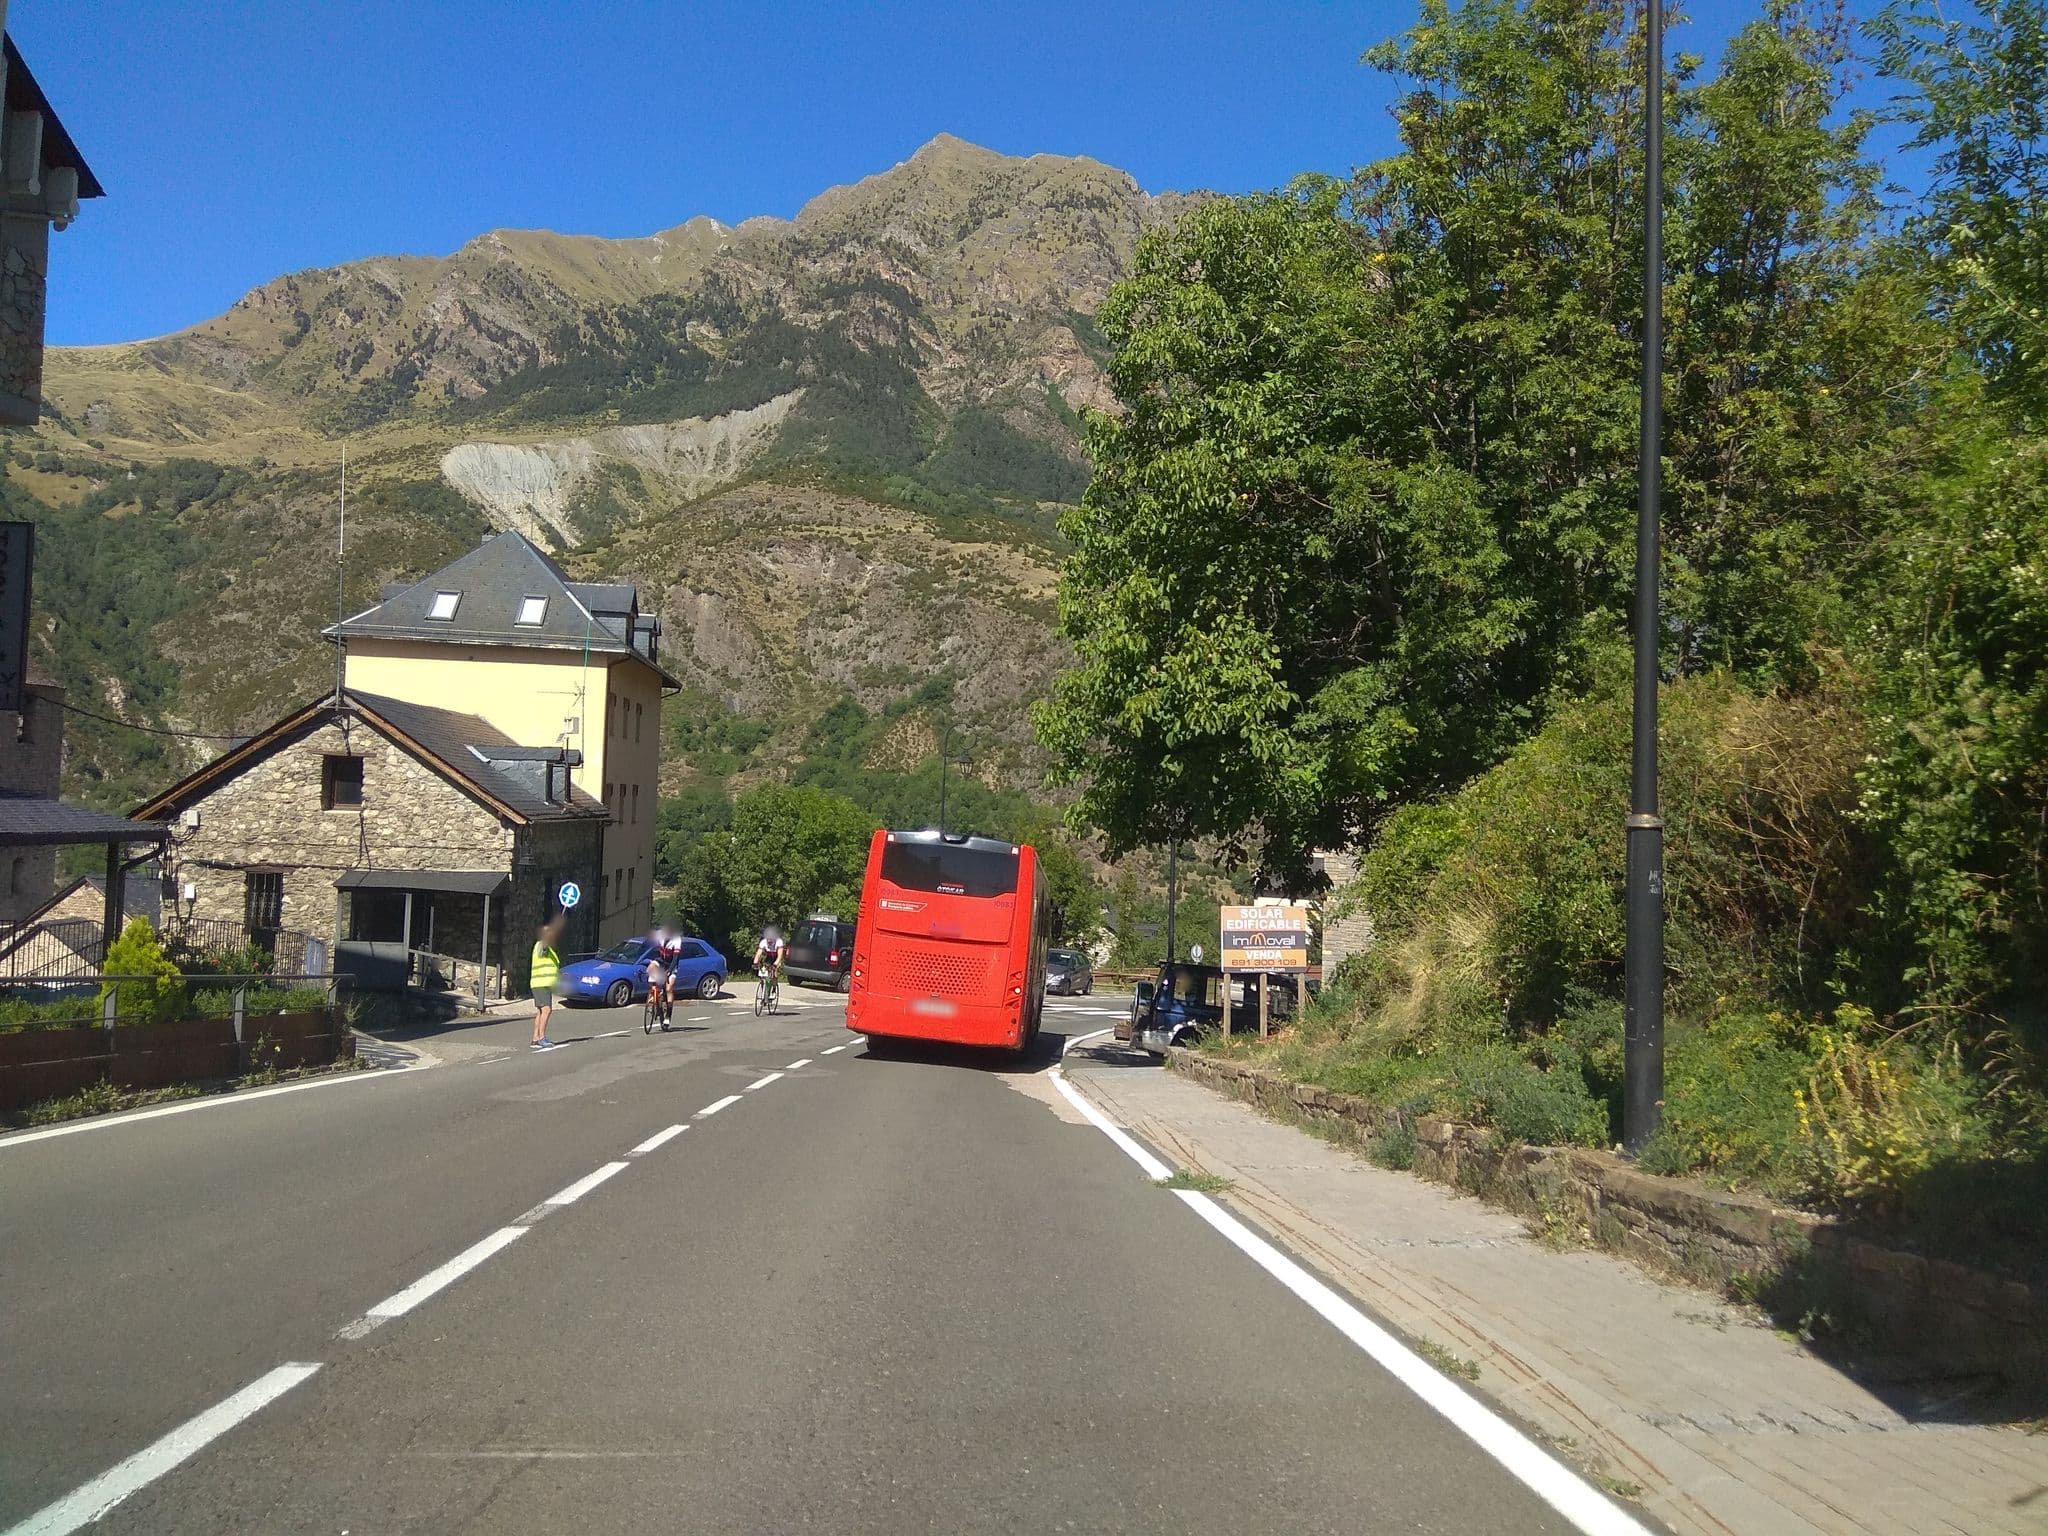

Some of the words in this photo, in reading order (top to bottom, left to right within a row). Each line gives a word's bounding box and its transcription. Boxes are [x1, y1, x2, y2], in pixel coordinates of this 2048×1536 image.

[936, 885, 965, 895] OTOKAR
[1240, 908, 1283, 918] SOLAR
[1226, 920, 1301, 929] EDIFICABLE
[1245, 950, 1283, 959] VENDA
